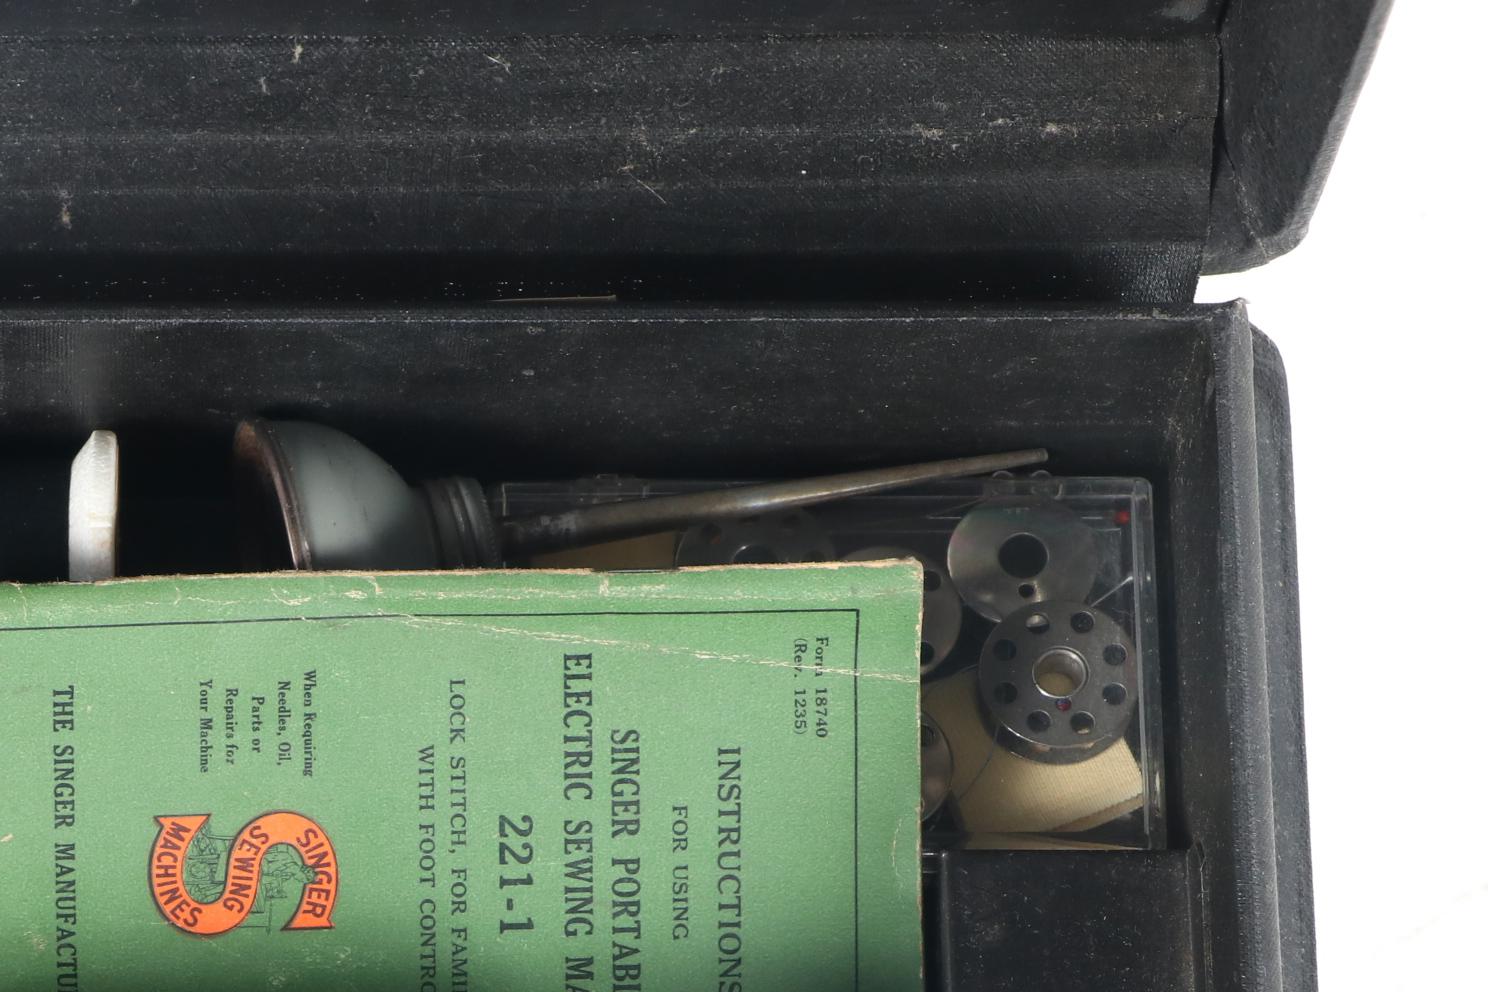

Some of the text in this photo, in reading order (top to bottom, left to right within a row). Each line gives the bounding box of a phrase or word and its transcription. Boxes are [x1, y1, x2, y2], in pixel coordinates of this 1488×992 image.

[53, 685, 74, 732] THE
[199, 680, 214, 773] Your Machine
[224, 688, 239, 765] Repairs for
[251, 697, 265, 753] Parts or
[276, 681, 292, 766] Needles, Oil,
[302, 669, 317, 777] When Requiring
[449, 679, 466, 745] LOCK
[563, 653, 594, 800] ELECTRIC
[793, 638, 809, 735] (Rev. 1235)
[815, 688, 828, 738] 18740
[53, 745, 76, 829] SINGER
[418, 745, 435, 812] WITH
[448, 756, 469, 854] STITCH,
[610, 729, 642, 838] SINGER
[155, 821, 203, 928] MACHINES
[223, 825, 269, 915] SEWING
[296, 827, 333, 919] SINGER
[419, 824, 436, 887] FOOT
[450, 867, 469, 914] FOR
[498, 815, 536, 935] 221-1
[563, 820, 595, 937] SEWING
[672, 805, 690, 941] FOR USING
